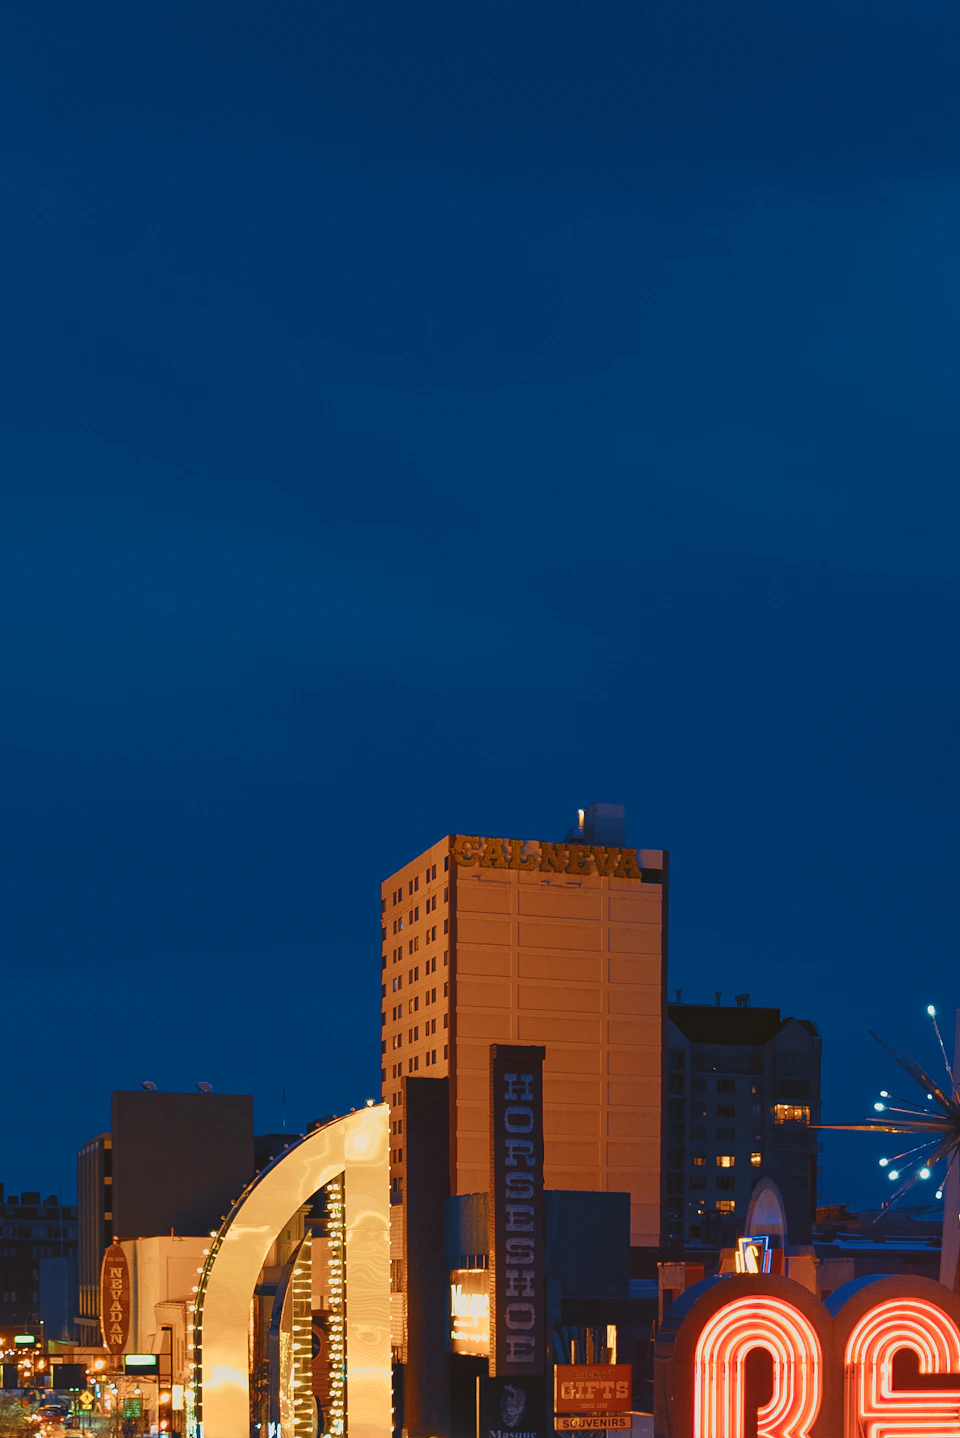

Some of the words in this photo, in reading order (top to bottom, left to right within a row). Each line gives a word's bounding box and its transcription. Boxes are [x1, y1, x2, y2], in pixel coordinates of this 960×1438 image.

[453, 835, 534, 871] CAL
[540, 841, 642, 878] NEVA
[503, 1073, 535, 1363] HORSESHOE
[109, 1267, 124, 1345] NEVADAN
[573, 1370, 605, 1379] Lucky
[608, 1370, 616, 1378] 7
[561, 1381, 629, 1400] GIFTS
[562, 1418, 626, 1429] SOUVENIRS
